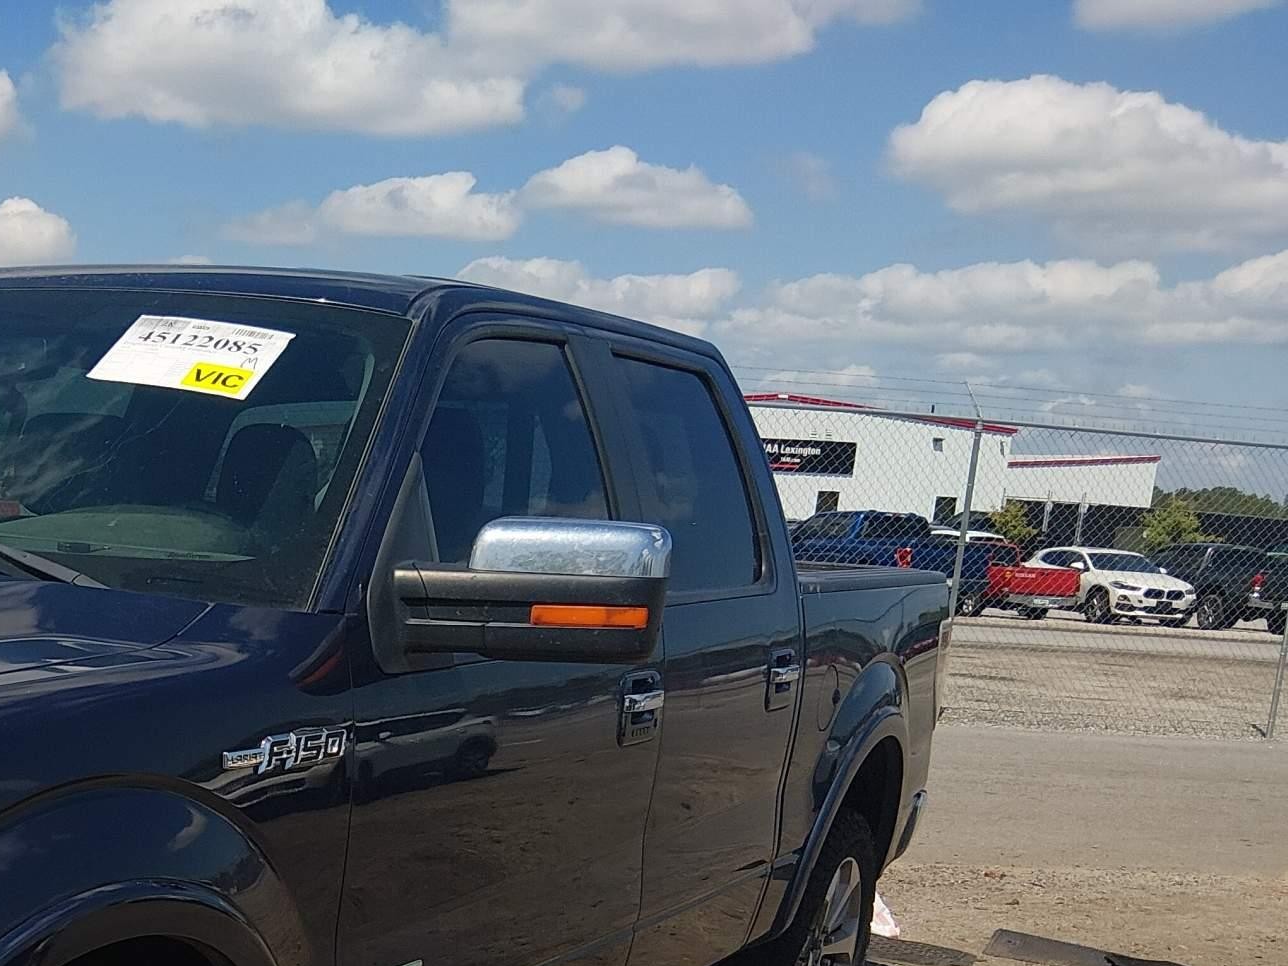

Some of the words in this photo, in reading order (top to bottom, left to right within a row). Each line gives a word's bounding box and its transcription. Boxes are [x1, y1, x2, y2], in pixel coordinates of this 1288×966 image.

[138, 330, 262, 355] 45122085
[195, 368, 244, 388] VIC
[780, 444, 821, 456] Lexington
